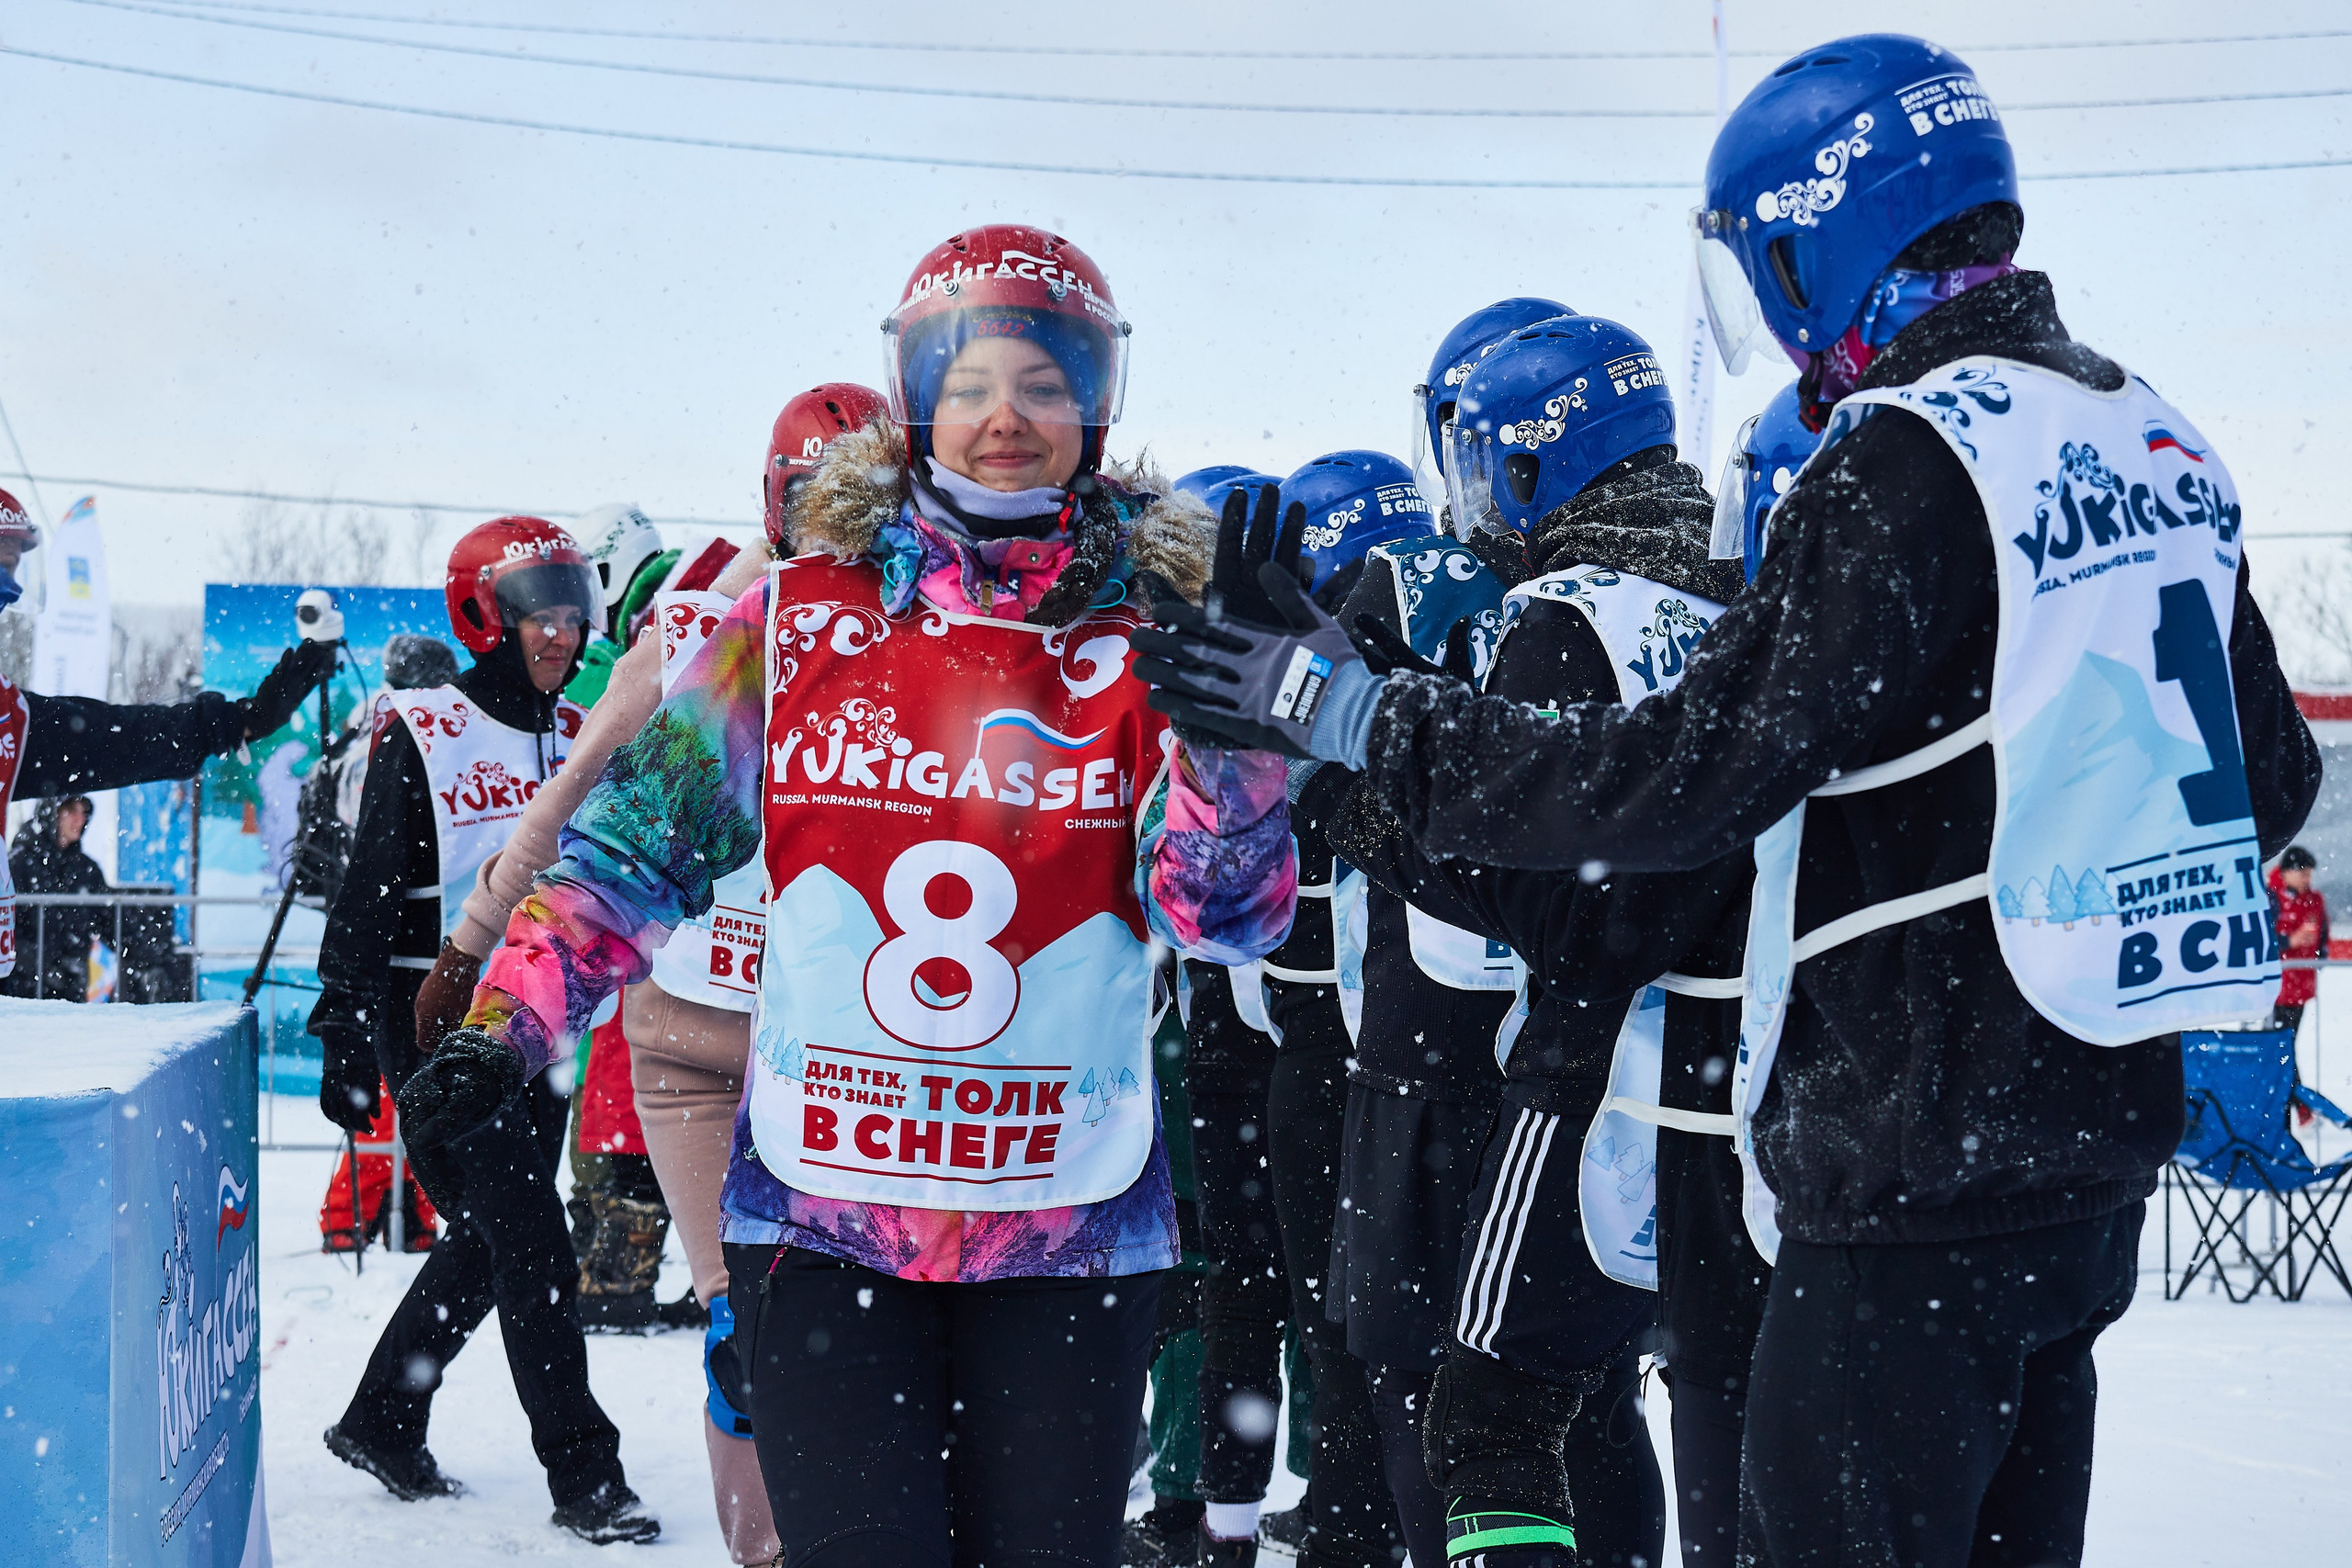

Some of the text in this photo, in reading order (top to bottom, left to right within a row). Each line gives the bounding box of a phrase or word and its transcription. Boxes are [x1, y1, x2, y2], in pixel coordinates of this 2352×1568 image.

[1909, 111, 1934, 137] В
[1613, 379, 1629, 396] В
[1380, 502, 1394, 516] В
[2153, 579, 2255, 827] 1
[772, 794, 933, 817] RUSSIA, MURMANSK REGION
[2118, 863, 2223, 908] ДЛЯ ТЕХ,
[713, 916, 742, 931] ДЛЯ
[2120, 889, 2227, 929] КТО ЗНАЕТ
[712, 930, 735, 942] КТО
[863, 840, 1021, 1053] 8
[710, 945, 733, 977] В
[2118, 931, 2163, 989] В
[806, 1060, 908, 1092] ДЛЯ ТЕХ,
[804, 1081, 907, 1110] КТО ЗНАЕТ
[921, 1075, 1069, 1116] ТОЛК
[802, 1104, 1062, 1170] В СНЕГЕ
